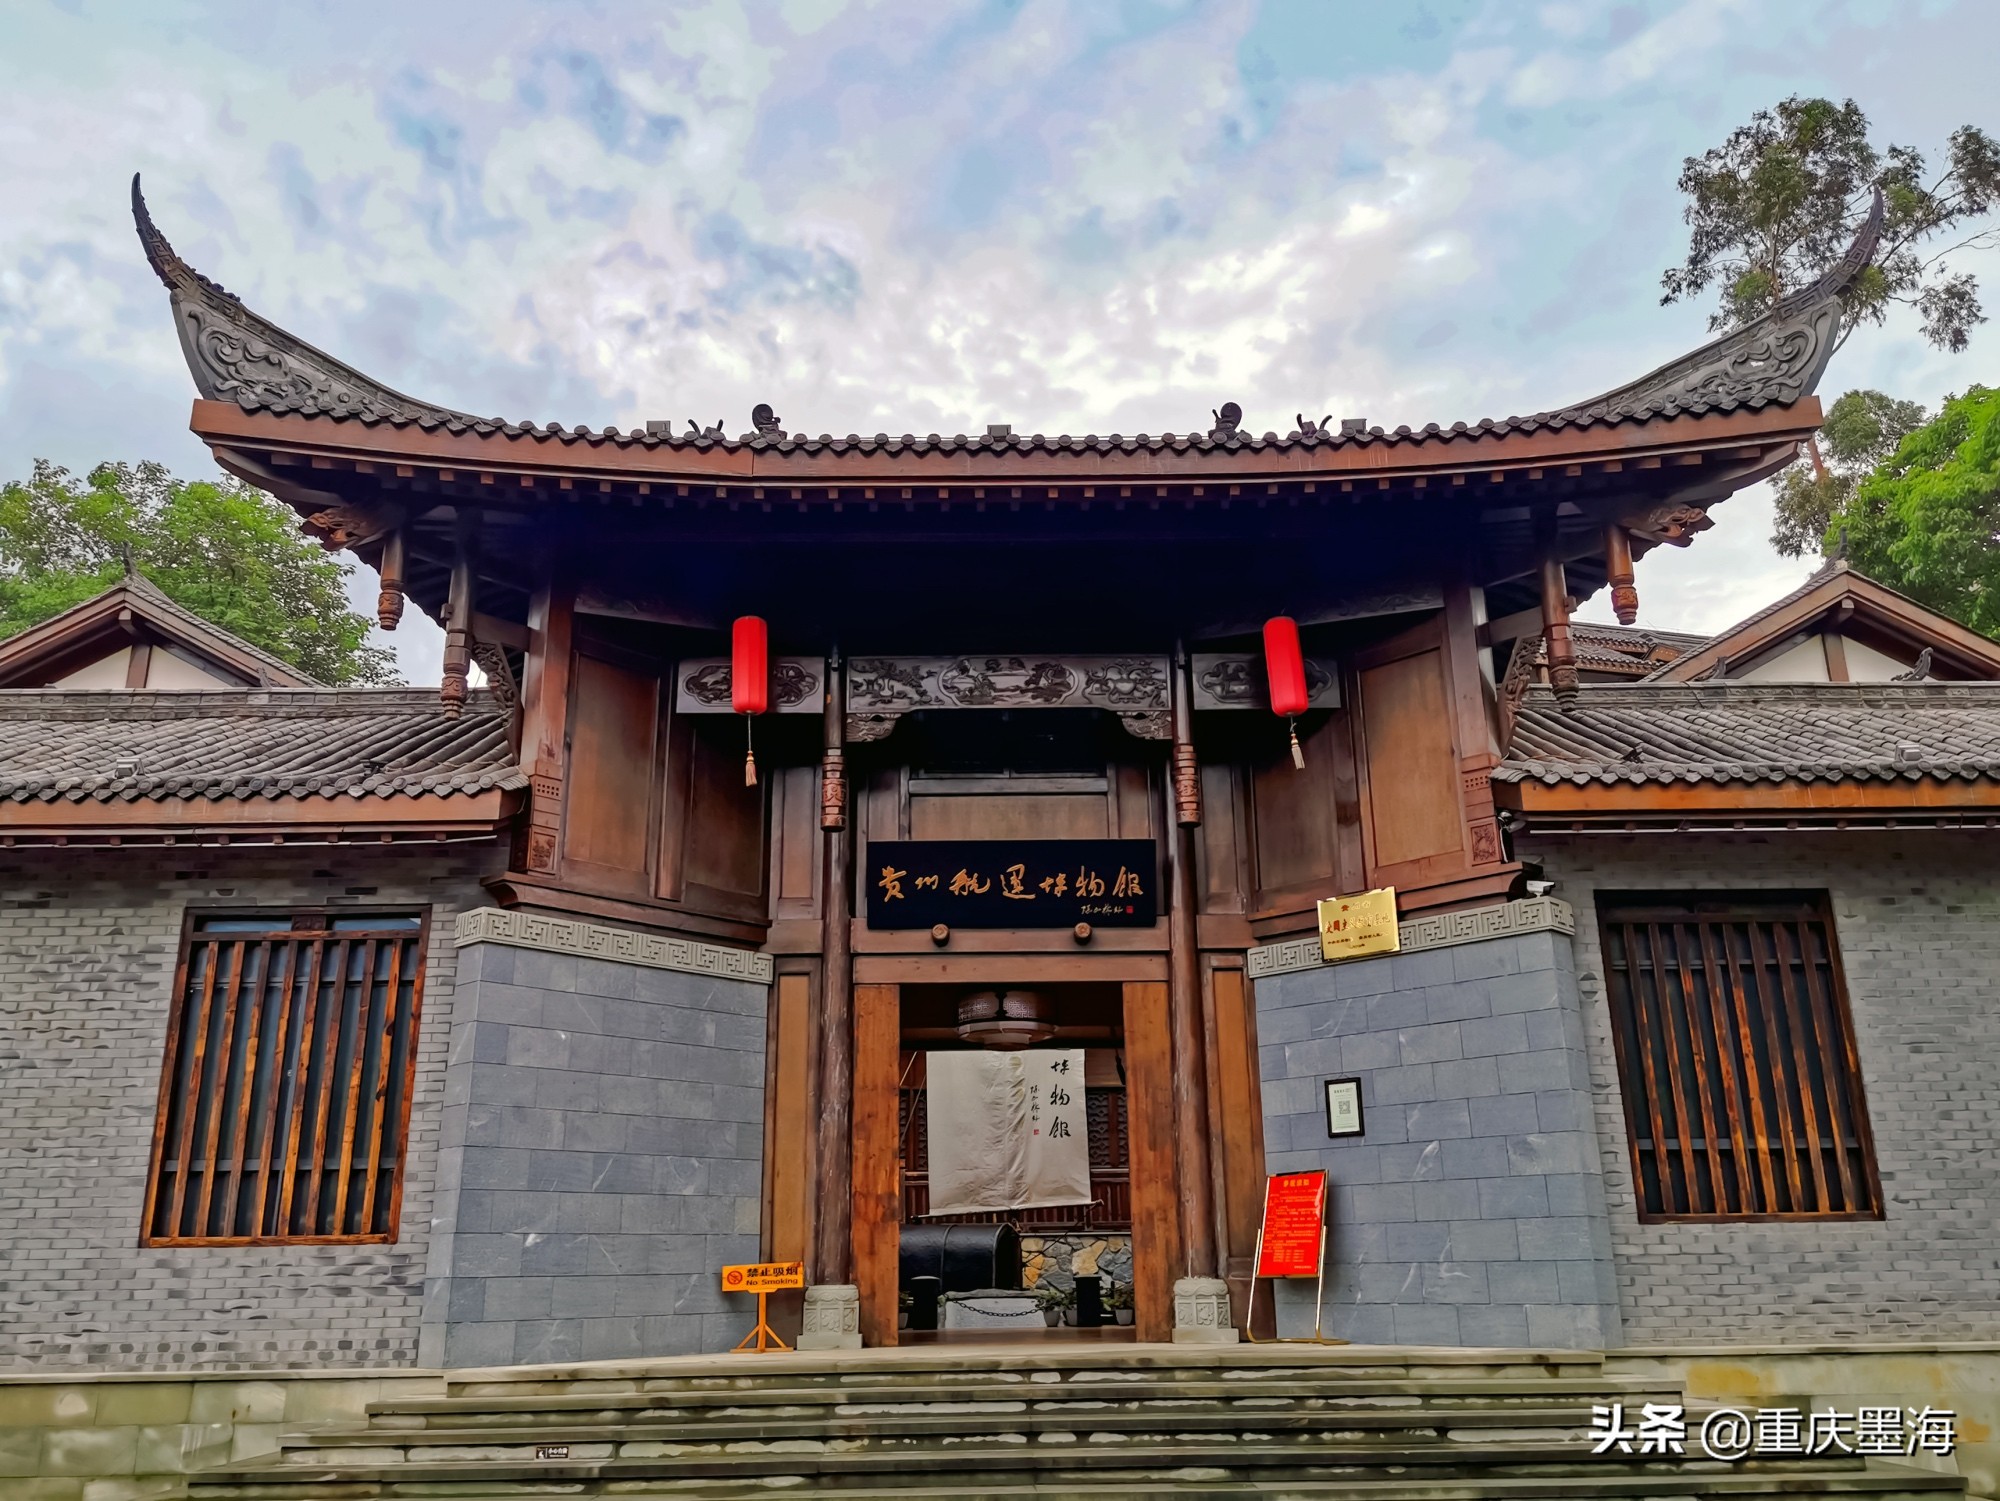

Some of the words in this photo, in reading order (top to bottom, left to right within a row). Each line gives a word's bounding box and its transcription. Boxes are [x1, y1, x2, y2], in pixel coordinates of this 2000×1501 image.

[747, 1267, 798, 1278] 禁止吸烟
[761, 1278, 798, 1286] Smoking
